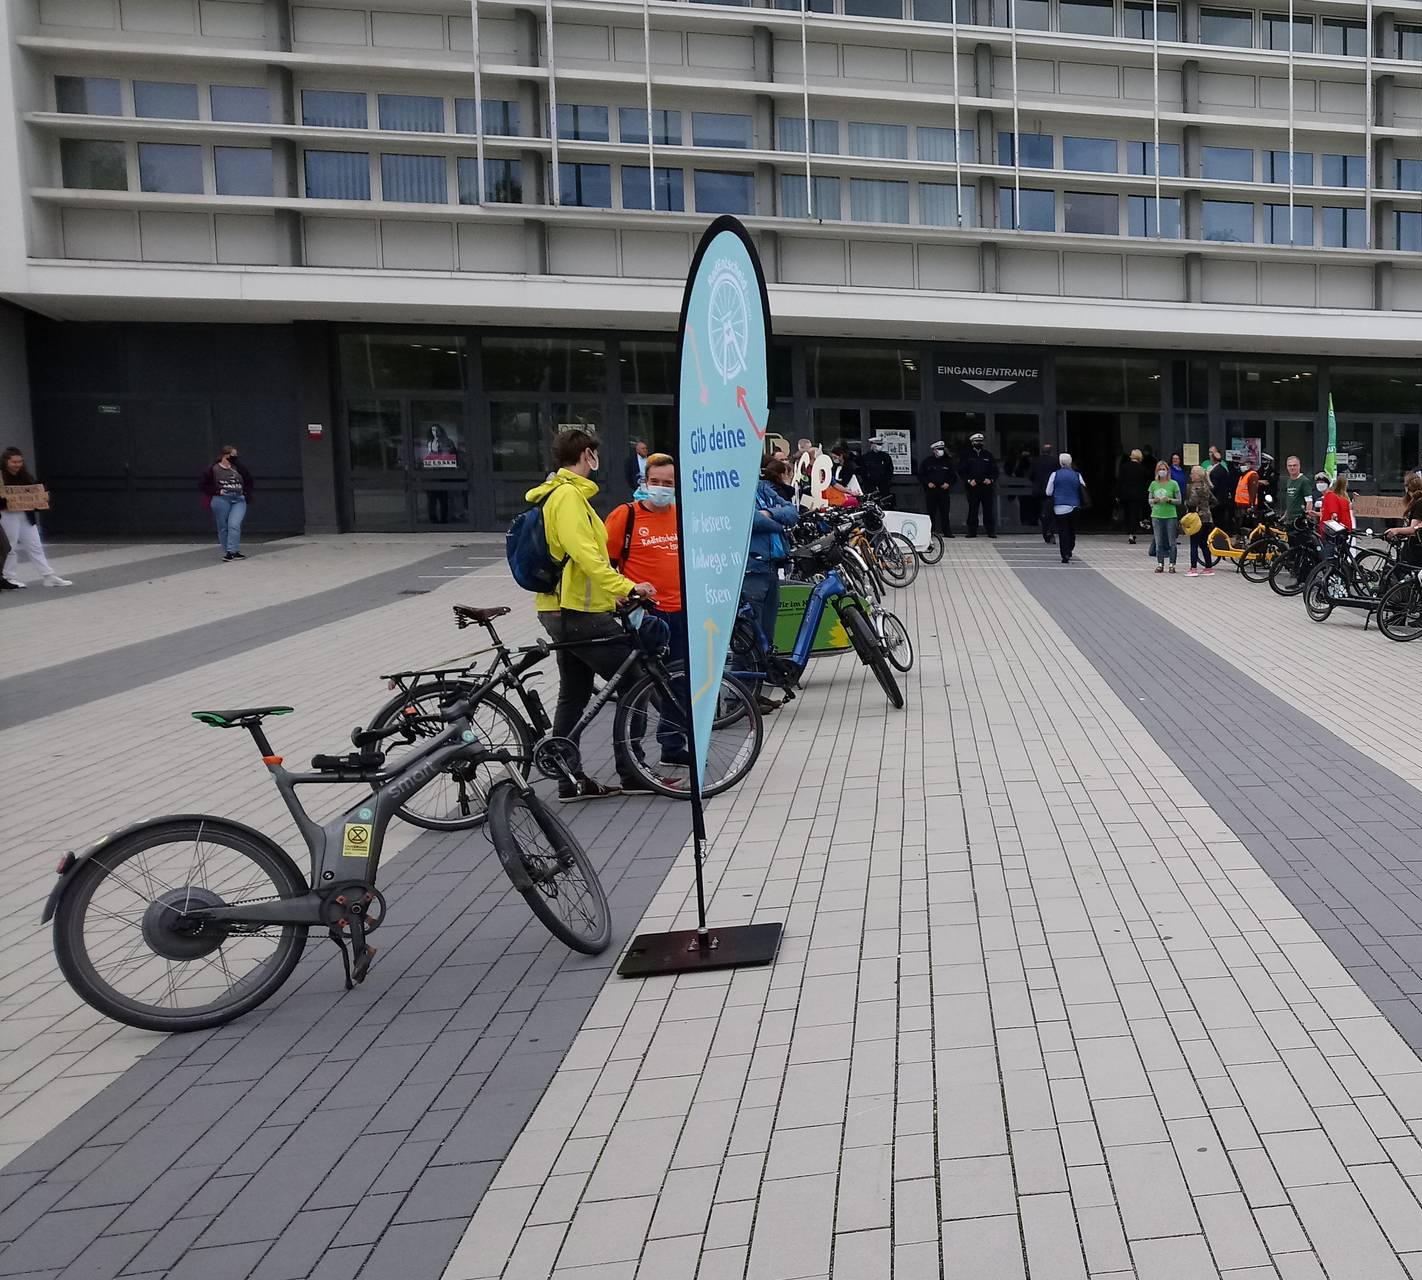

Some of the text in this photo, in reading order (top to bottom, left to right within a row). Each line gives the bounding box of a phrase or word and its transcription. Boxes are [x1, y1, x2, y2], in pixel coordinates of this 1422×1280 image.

[937, 366, 1039, 377] EINGANG/ENTRANCE
[691, 423, 746, 454] Gib deine
[692, 466, 740, 492] Stimme
[388, 760, 437, 799] smart
